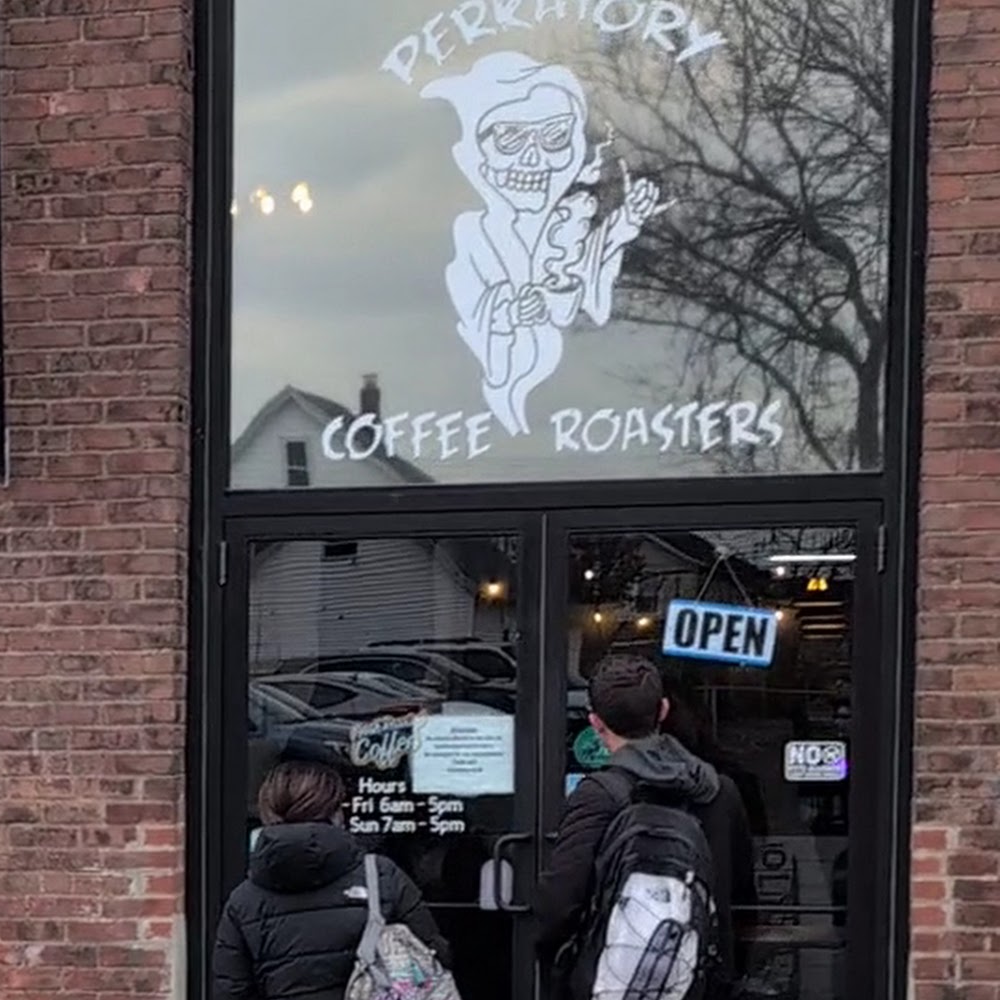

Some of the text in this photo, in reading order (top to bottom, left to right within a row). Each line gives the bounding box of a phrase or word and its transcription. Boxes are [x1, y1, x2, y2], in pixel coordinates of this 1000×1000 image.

[321, 400, 783, 461] COFFEE ROASTERS
[674, 608, 769, 657] OPEN
[358, 777, 406, 794] Hours
[352, 796, 374, 813] Fri
[380, 796, 414, 813] 6am
[428, 795, 463, 816] 5pm
[350, 815, 380, 833] Sun
[381, 815, 416, 834] 7am
[429, 814, 465, 836] 5pm
